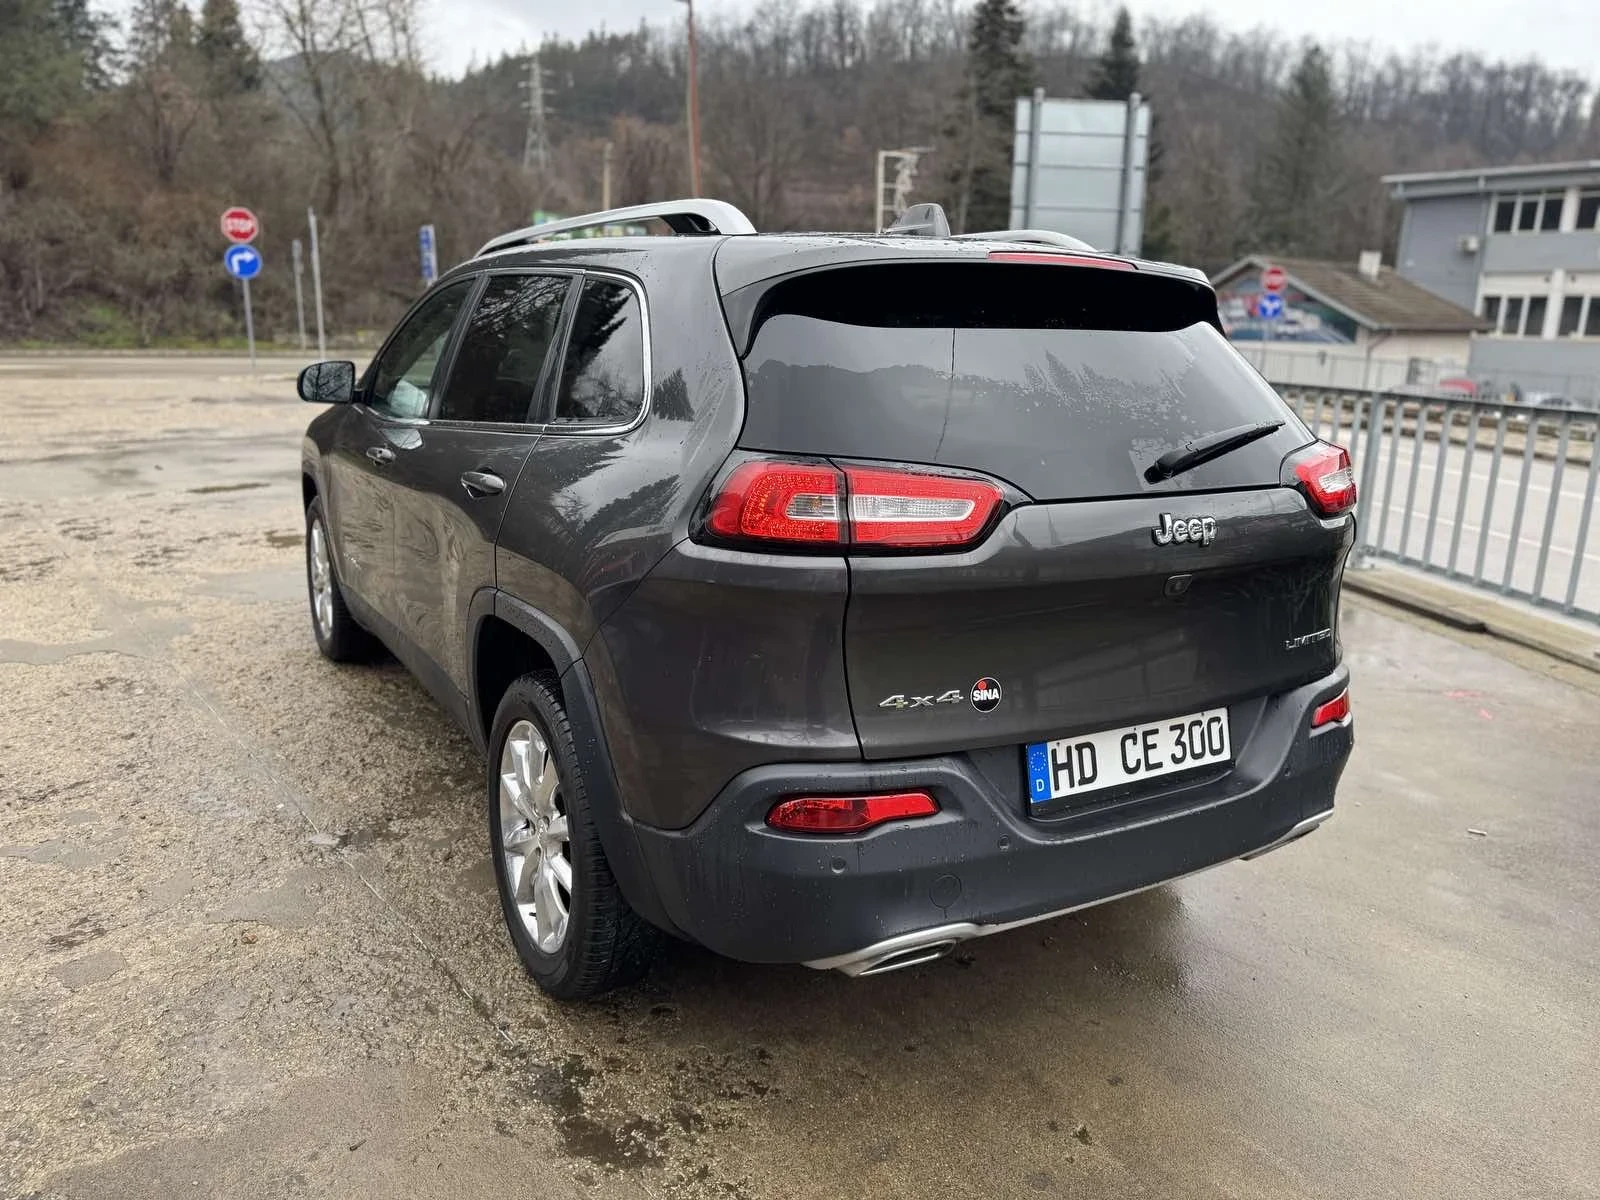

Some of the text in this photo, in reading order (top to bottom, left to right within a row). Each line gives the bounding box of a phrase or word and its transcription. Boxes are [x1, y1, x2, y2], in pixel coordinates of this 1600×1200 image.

[1153, 513, 1217, 545] Jeep
[1051, 716, 1225, 791] HD CE 300
[1036, 779, 1045, 791] D
